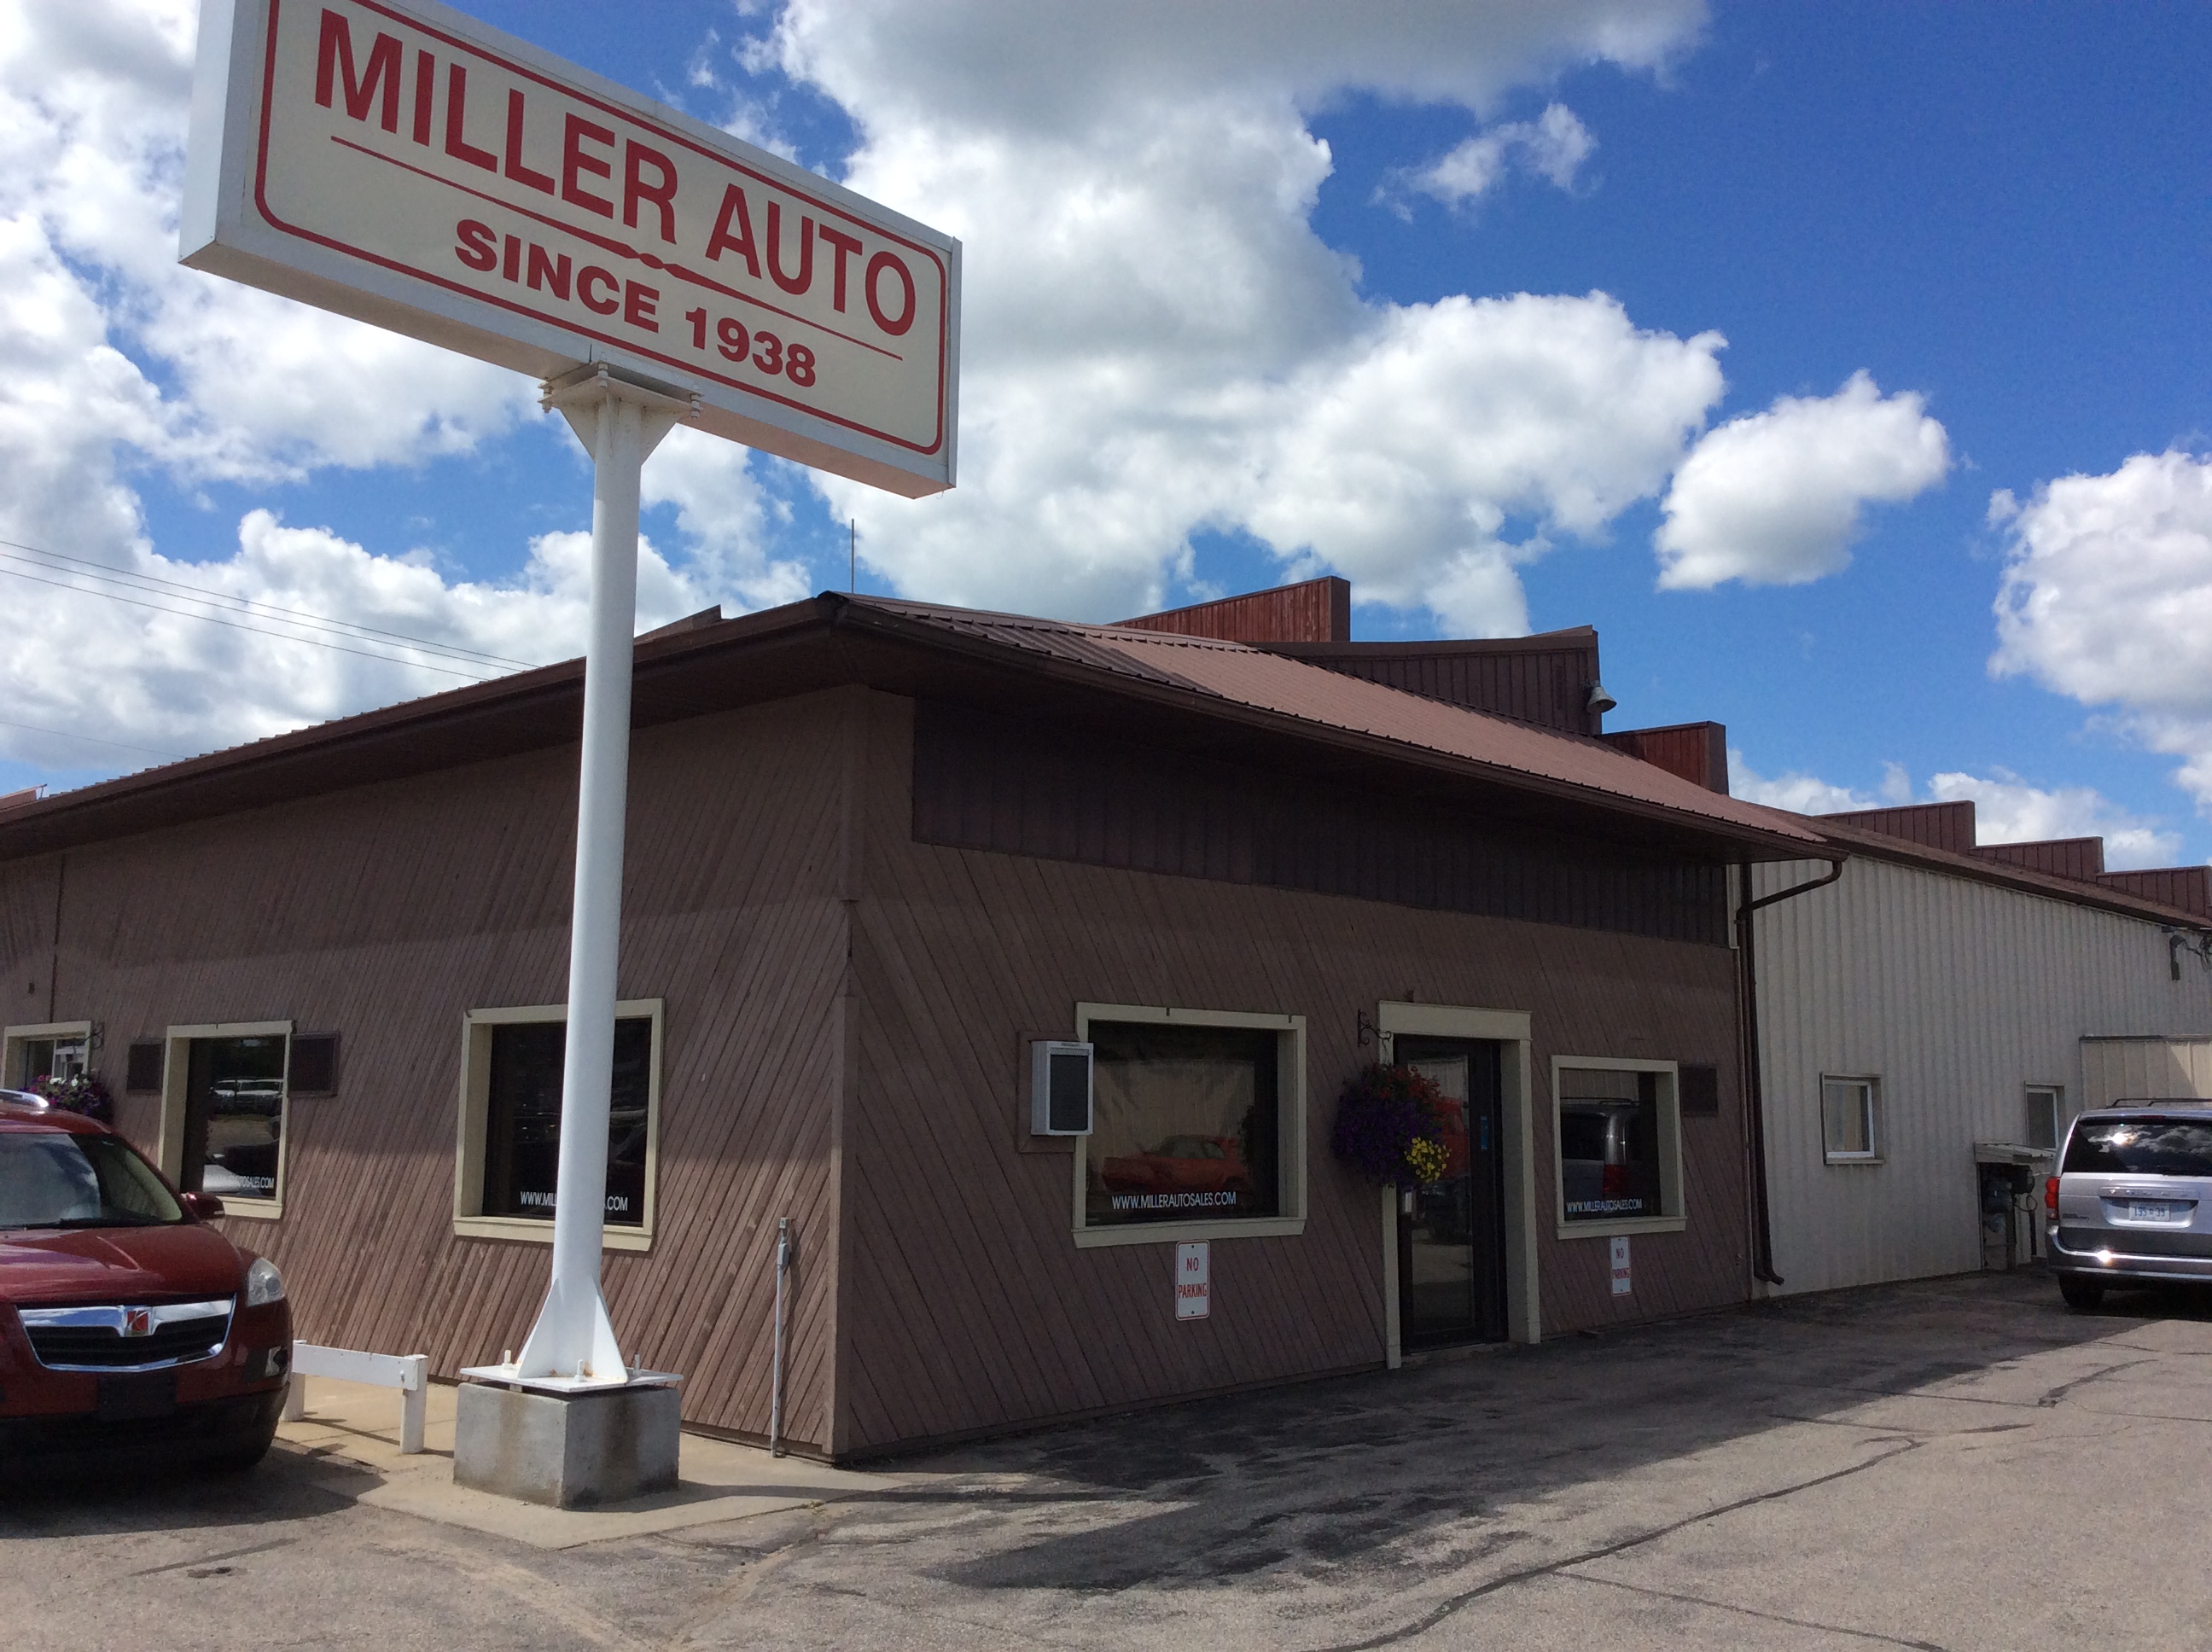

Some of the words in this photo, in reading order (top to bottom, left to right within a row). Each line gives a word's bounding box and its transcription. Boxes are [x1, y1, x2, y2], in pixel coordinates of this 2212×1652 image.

[315, 8, 678, 245] MILLER
[706, 183, 917, 337] AUTO
[454, 219, 661, 333] SINCE
[686, 307, 816, 388] 1938
[1112, 1192, 1236, 1209] WWW.MILLERAUTOSALES.COM
[1186, 1257, 1199, 1271] NO
[1179, 1283, 1208, 1299] PARKING
